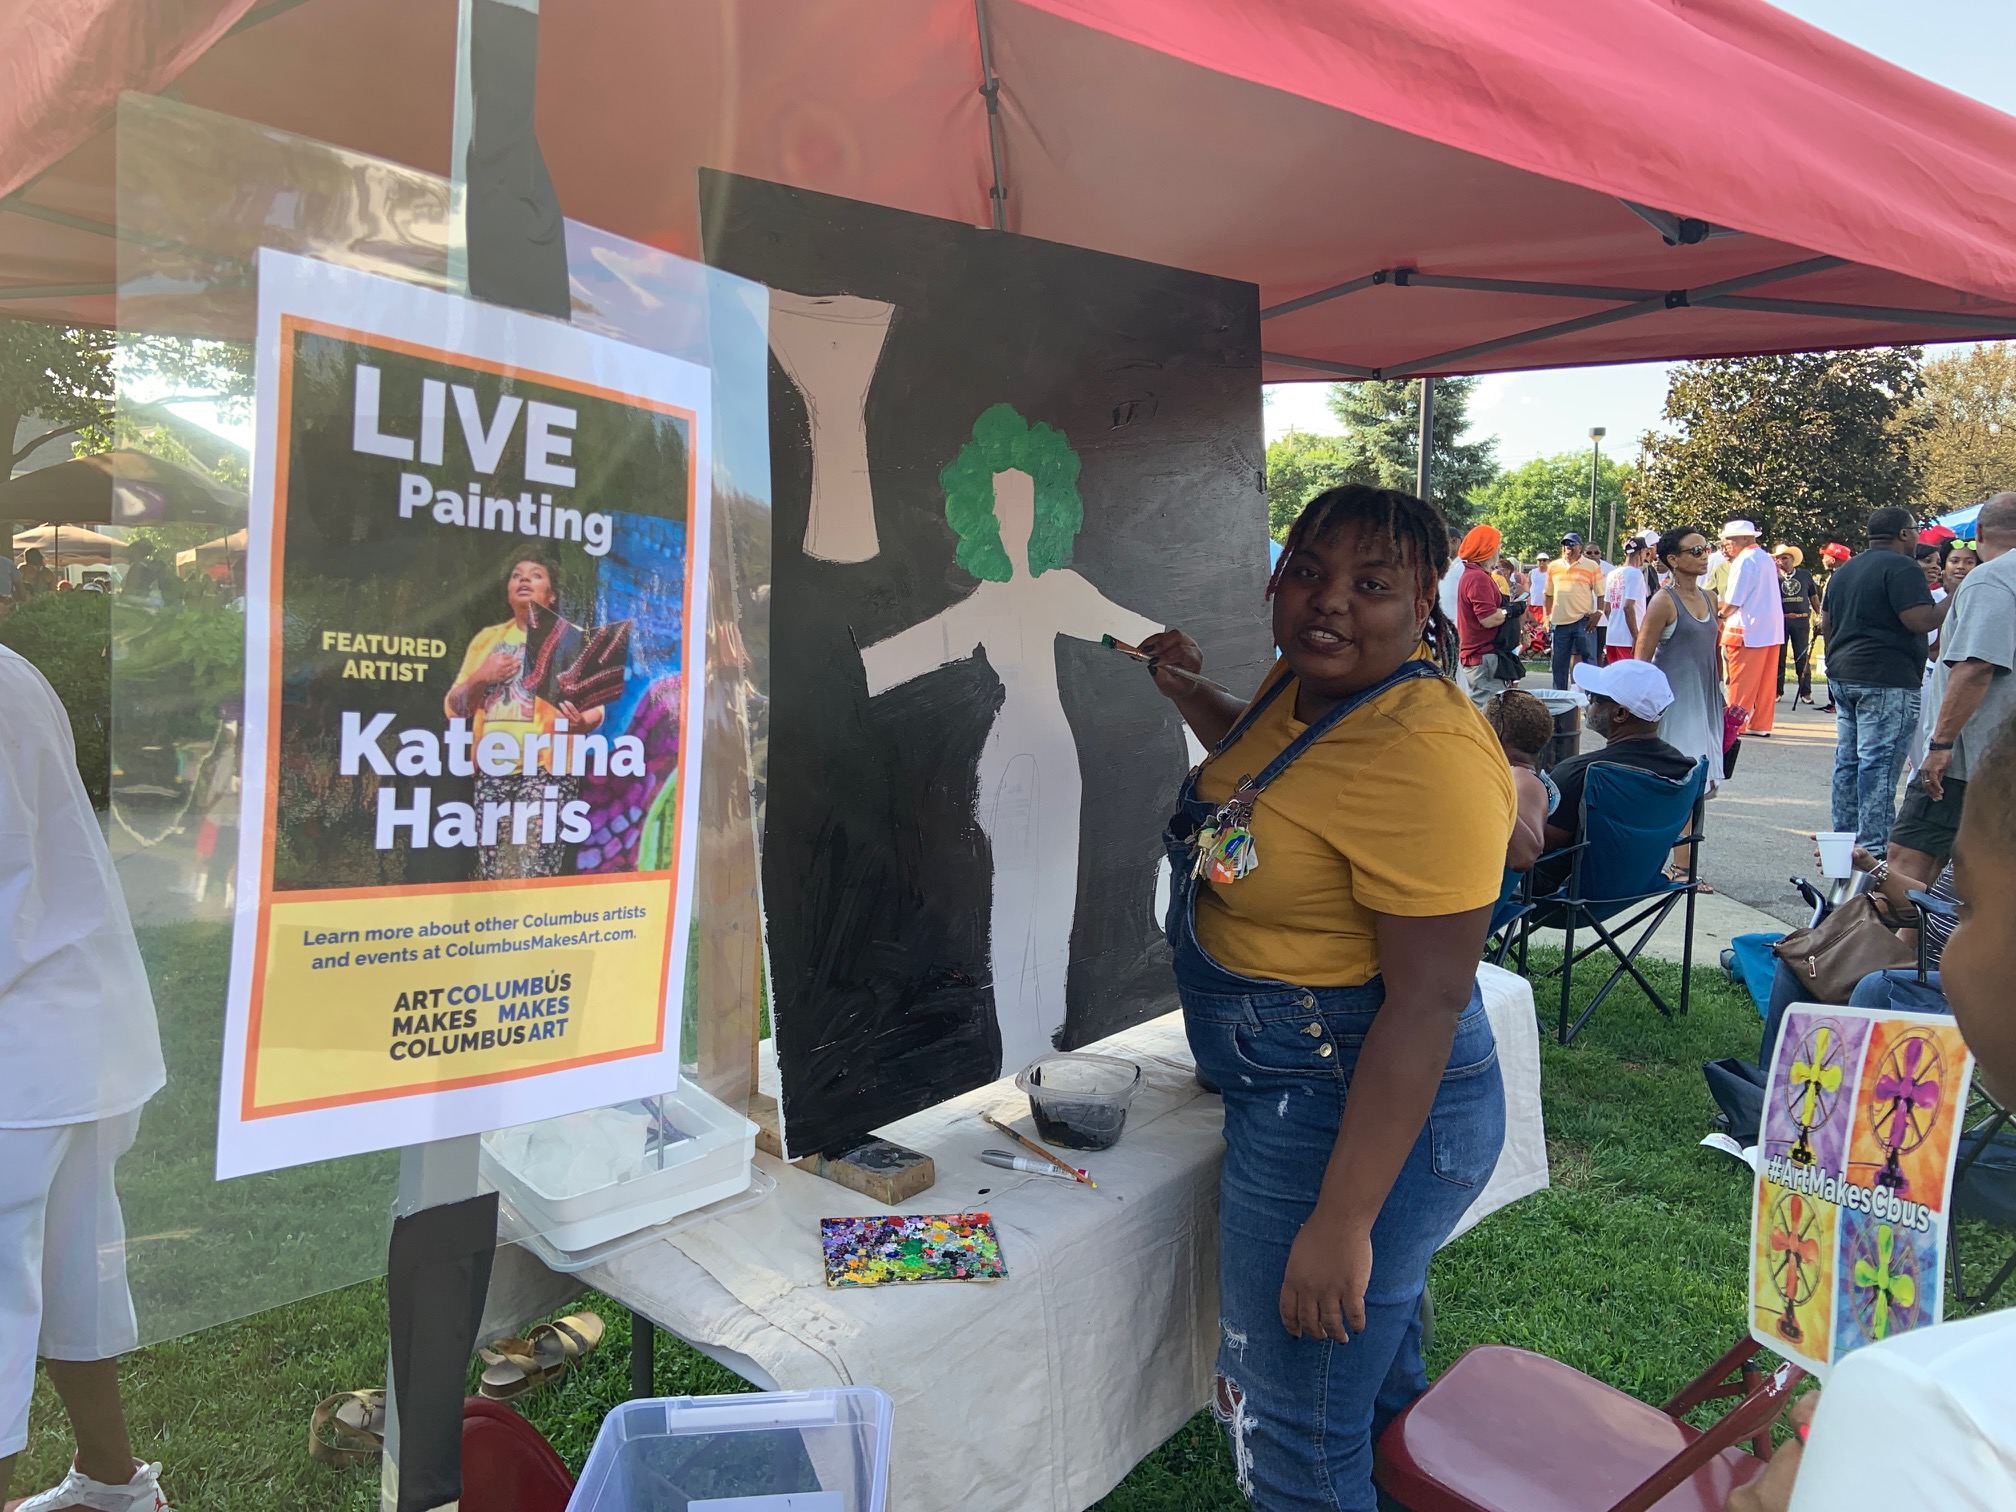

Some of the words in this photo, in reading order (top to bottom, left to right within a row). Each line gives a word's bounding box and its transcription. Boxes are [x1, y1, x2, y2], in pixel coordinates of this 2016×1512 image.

[353, 364, 577, 488] LIVE
[399, 472, 613, 557] Painting
[322, 631, 447, 658] FEATURED
[342, 659, 428, 682] ARTIST
[340, 711, 646, 778] Katerina
[375, 786, 593, 850] Harris
[303, 930, 360, 946] Learn
[365, 926, 414, 941] more
[418, 919, 470, 937] about
[474, 917, 519, 932] other
[523, 910, 599, 928] Columbus
[602, 905, 647, 921] artists
[311, 952, 350, 970] and
[355, 948, 418, 966] events
[423, 945, 441, 960] at
[446, 929, 637, 958] ColumbusMakesArt.com.
[393, 988, 445, 1012] ART
[447, 971, 572, 1006] COLUMBUS
[392, 1008, 477, 1037] MAKES
[498, 995, 570, 1023] MAKES
[389, 1025, 526, 1061] COLUMBUS
[527, 1017, 569, 1042] ART
[1768, 1154, 1930, 1233] #ArtMakesCbus
